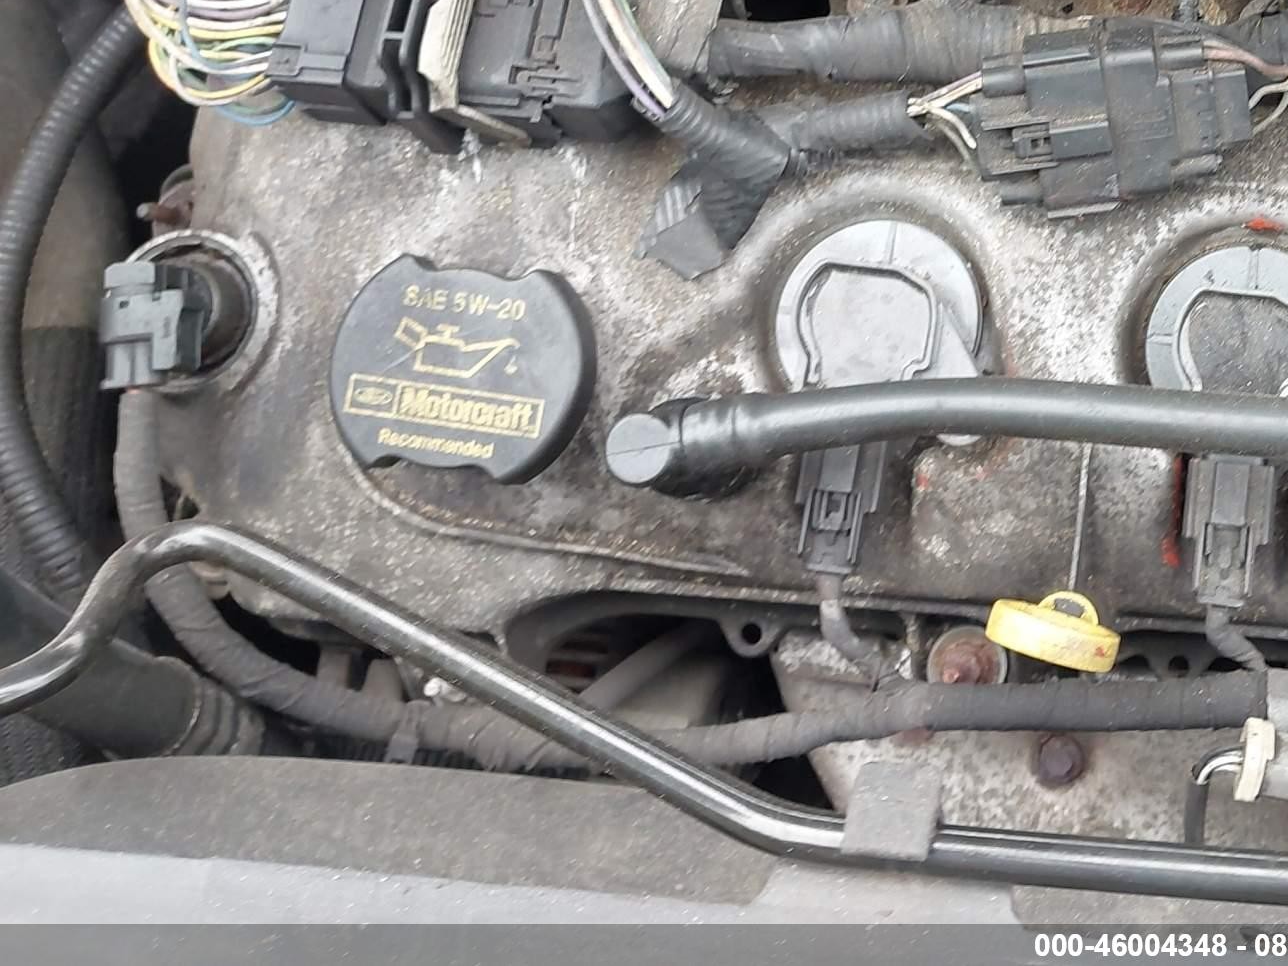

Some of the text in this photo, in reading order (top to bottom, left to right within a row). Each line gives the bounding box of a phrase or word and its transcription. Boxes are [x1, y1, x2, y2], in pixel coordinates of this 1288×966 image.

[403, 284, 526, 321] SAE 5W-20
[400, 386, 534, 431] Motorcraft
[377, 427, 495, 459] Recommended
